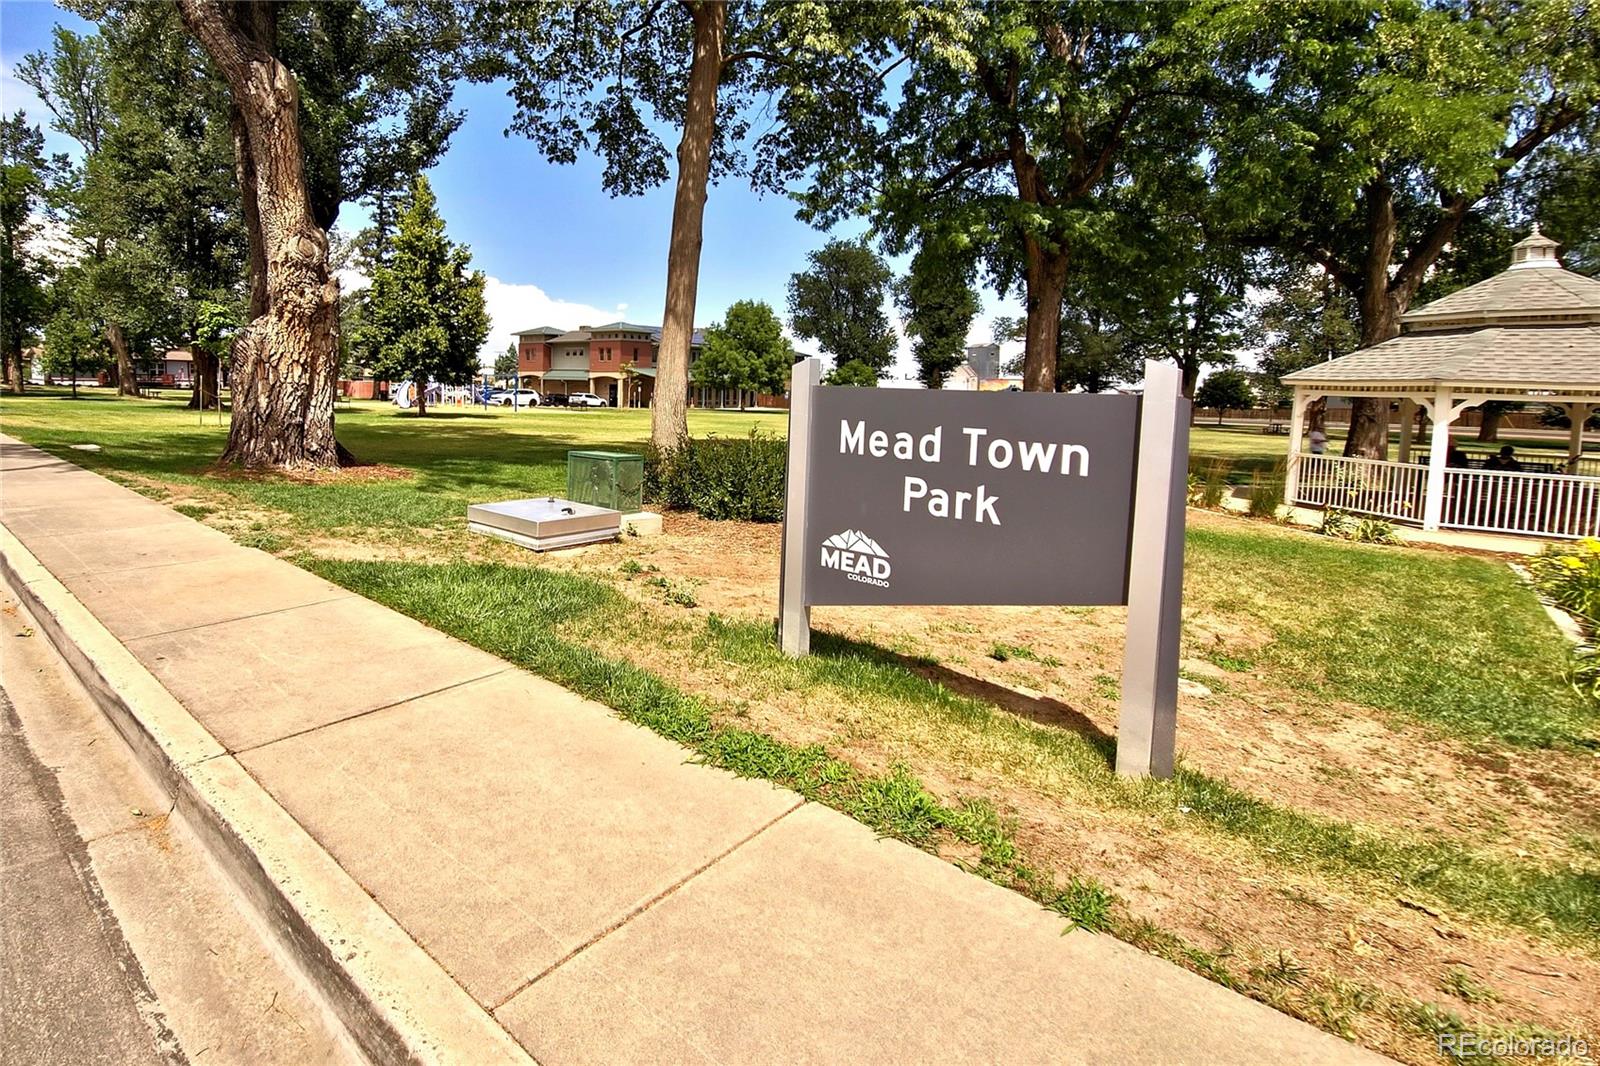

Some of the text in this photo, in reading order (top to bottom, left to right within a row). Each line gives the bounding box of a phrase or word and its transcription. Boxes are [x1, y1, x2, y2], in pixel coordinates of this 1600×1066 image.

[839, 419, 1090, 477] Mead Town
[903, 476, 1001, 526] Park
[820, 547, 891, 580] MEAD
[847, 573, 890, 588] COLORADO
